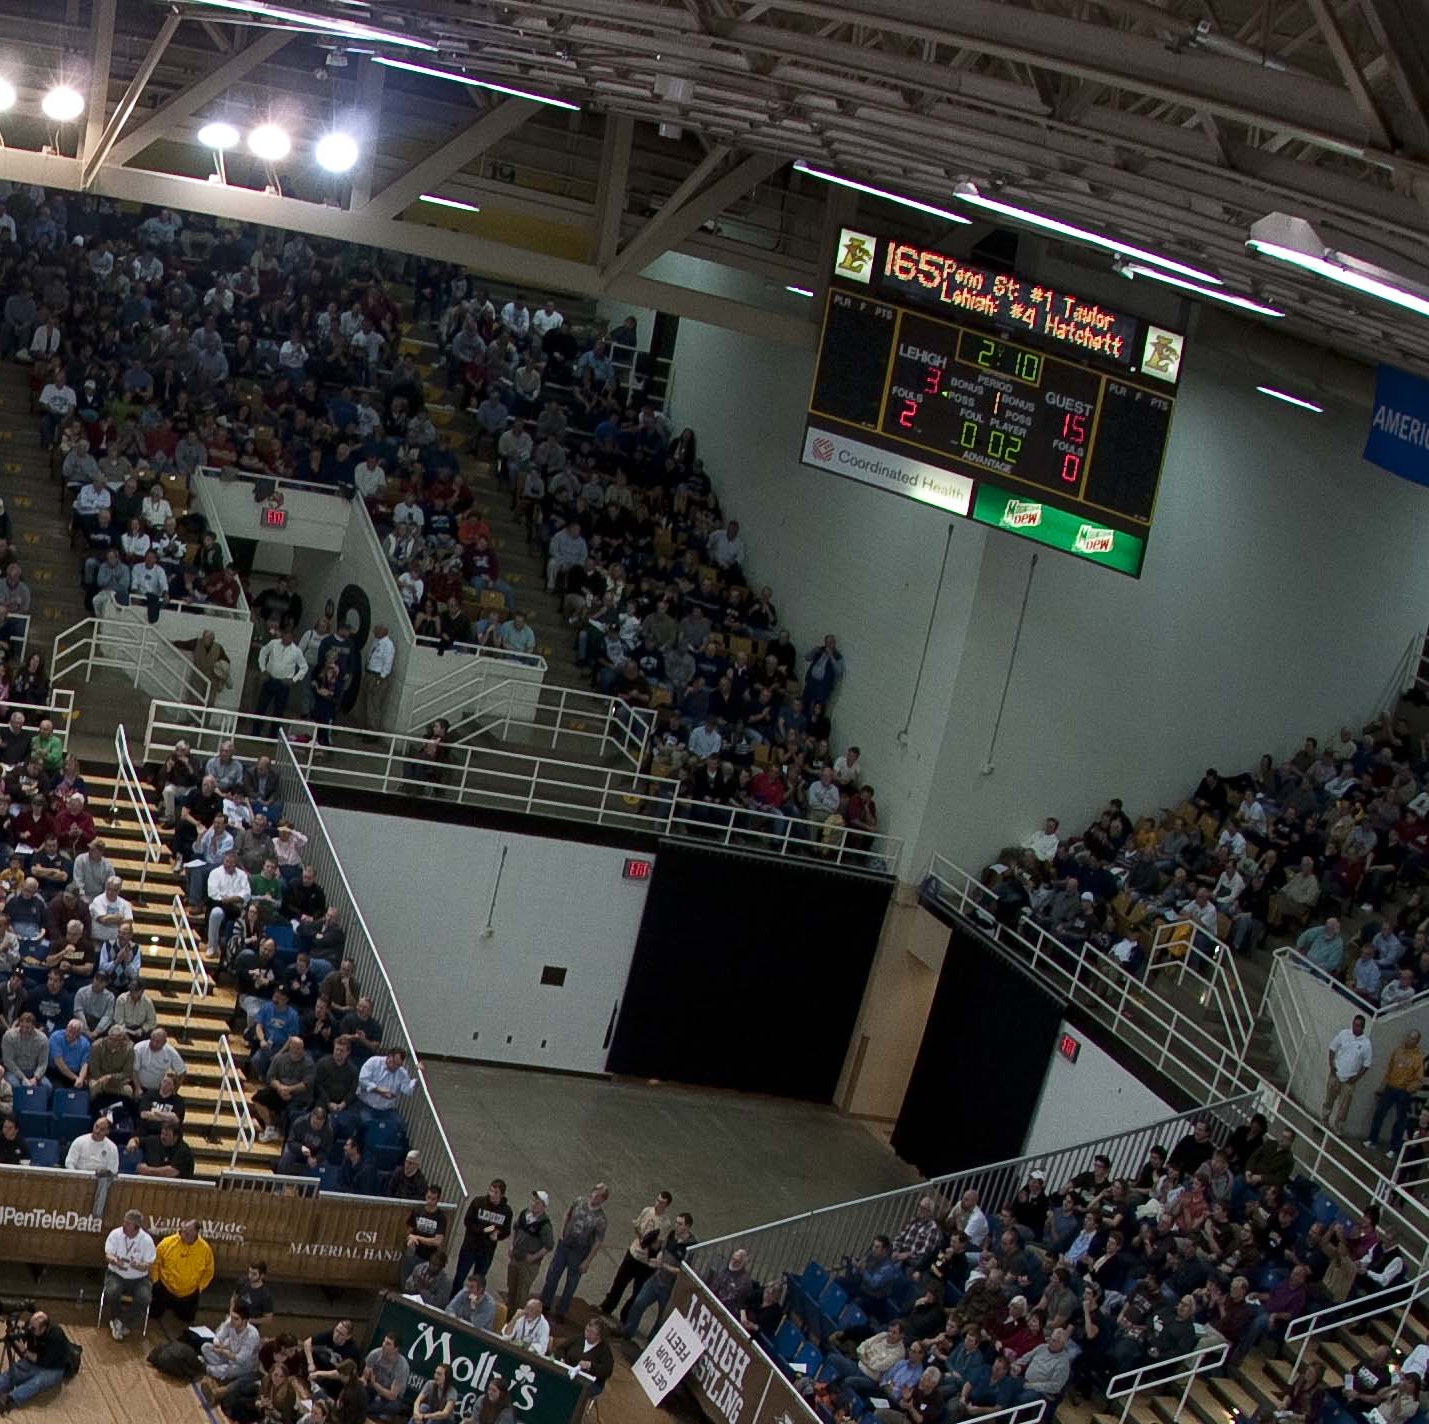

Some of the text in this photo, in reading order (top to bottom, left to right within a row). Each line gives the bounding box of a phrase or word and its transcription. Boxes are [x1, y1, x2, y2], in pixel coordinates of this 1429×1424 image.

[884, 241, 943, 289] 165
[942, 257, 984, 291] Penn
[1030, 284, 1053, 312] #1
[1064, 297, 1116, 331] Taylor
[1010, 302, 1037, 329] #4
[899, 343, 948, 369] LEHIGH
[923, 367, 942, 394] 3
[950, 377, 984, 394] BONUS
[977, 373, 1013, 393] PERIOD
[892, 386, 924, 403] FOULS
[948, 392, 976, 407] POSS
[1002, 394, 1035, 413] BONUS
[1045, 391, 1093, 417] GUEST
[899, 400, 918, 429] 2
[960, 408, 1027, 438] FOUL PLAYER
[1005, 410, 1032, 426] POSS
[1063, 413, 1085, 443] 15
[1053, 439, 1084, 456] FOULS
[962, 451, 1013, 475] ADVANTAGE
[1062, 454, 1079, 483] 0
[838, 450, 965, 503] Coordinated Health
[4, 1208, 102, 1232] PenTeleData
[355, 1230, 377, 1244] CSI
[291, 1242, 361, 1260] MATERIAL
[666, 1327, 691, 1363] FEET!
[686, 1293, 751, 1391] LEHIGH
[643, 1355, 668, 1392] GET ON
[656, 1346, 678, 1375] YOUR
